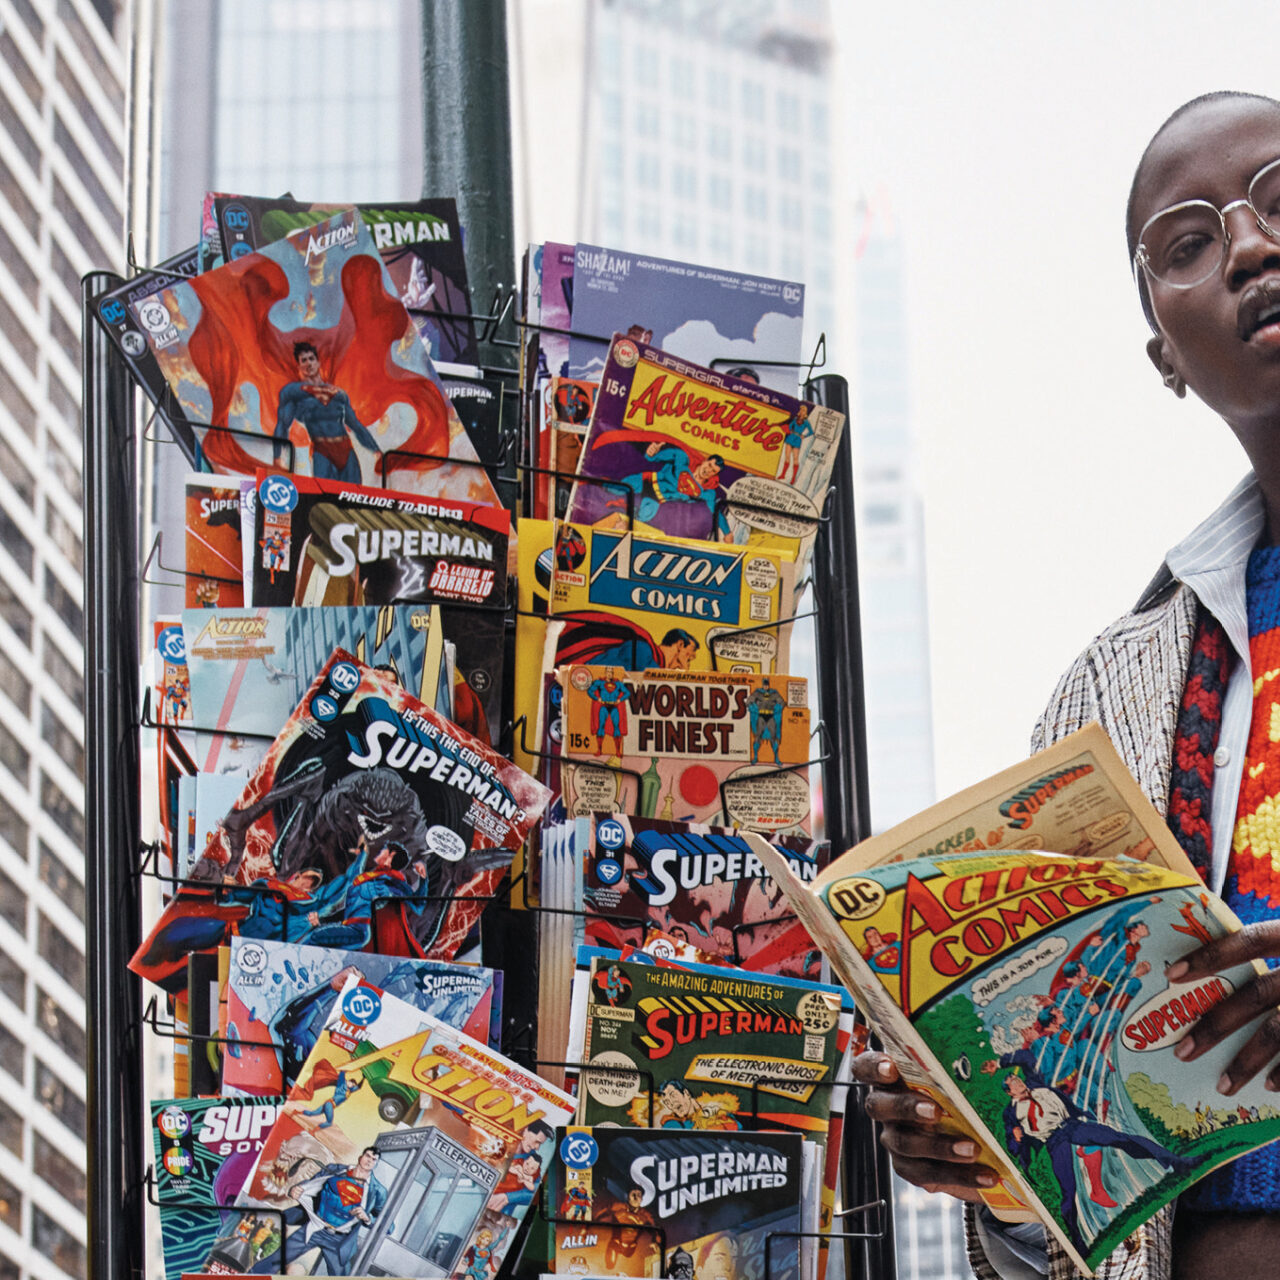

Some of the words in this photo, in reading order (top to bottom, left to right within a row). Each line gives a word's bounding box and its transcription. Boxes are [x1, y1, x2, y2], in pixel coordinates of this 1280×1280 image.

[226, 207, 249, 227] DC
[304, 222, 355, 267] ACTION
[577, 249, 631, 277] SHAZAM!
[636, 261, 685, 276] ADVENTURES
[783, 286, 801, 300] DC
[101, 301, 126, 324] DC
[644, 349, 730, 390] SUPERGIRL
[606, 378, 627, 398] 15¢
[627, 374, 785, 452] Adventure
[680, 421, 741, 451] COMICS
[268, 487, 290, 505] DC
[338, 490, 395, 511] PRELUDE
[327, 522, 493, 577] SUPERMAN
[590, 531, 748, 586] ACTION
[429, 572, 494, 597] DARKSEID
[555, 573, 583, 585] ACTION
[433, 589, 458, 600] PART
[460, 594, 484, 604] TWO
[630, 587, 721, 619] COMICS
[193, 614, 270, 647] ACTION
[407, 614, 431, 630] DC
[719, 649, 740, 658] EVIL
[332, 665, 358, 690] DC
[708, 675, 747, 684] TOGETHER
[626, 682, 748, 720] WORLD'S
[402, 707, 417, 724] IS
[417, 716, 440, 740] THIS
[440, 735, 459, 754] THE
[459, 747, 481, 767] END
[569, 733, 590, 749] 15¢
[638, 719, 734, 756] FINEST
[600, 828, 624, 842] DC
[649, 848, 819, 907] SUPERAN
[844, 881, 880, 914] DC
[902, 860, 1108, 945] ACTION
[929, 875, 1129, 977] COMICS
[237, 974, 254, 985] ALL
[254, 974, 265, 985] IN
[422, 974, 482, 994] SUPERMAN
[646, 972, 661, 986] THE
[661, 971, 708, 993] AMAZING
[709, 979, 773, 1000] ADVENTURES
[773, 991, 784, 1001] OF
[979, 980, 999, 997] THIS
[1000, 974, 1009, 983] IS
[1017, 959, 1034, 972] JOB
[352, 999, 372, 1014] DC
[590, 1005, 600, 1017] DC
[601, 1008, 633, 1019] SUPERMAN
[804, 1010, 828, 1019] ONLY
[328, 1020, 355, 1036] ALL
[354, 1028, 370, 1042] IN
[646, 1008, 804, 1060] SUPERMAN
[605, 1071, 638, 1081] THING'S
[696, 1057, 714, 1069] THE
[715, 1058, 784, 1077] ELECTRONIC
[785, 1065, 822, 1081] GHOST
[335, 1029, 547, 1138] ACTION
[588, 1077, 636, 1088] DEATH-GRIP
[598, 1087, 610, 1095] ON
[611, 1089, 628, 1098] ME!
[710, 1070, 726, 1080] OF
[726, 1070, 808, 1095] METROPOLIS!
[164, 1114, 188, 1130] DC
[167, 1156, 190, 1167] PRIDE
[434, 1138, 494, 1185] TELEPHONE
[569, 1143, 590, 1160] DC
[630, 1152, 788, 1208] SUPERMAN
[658, 1173, 788, 1219] UNLIMITED
[561, 1235, 584, 1249] ALL
[584, 1234, 598, 1247] IN
